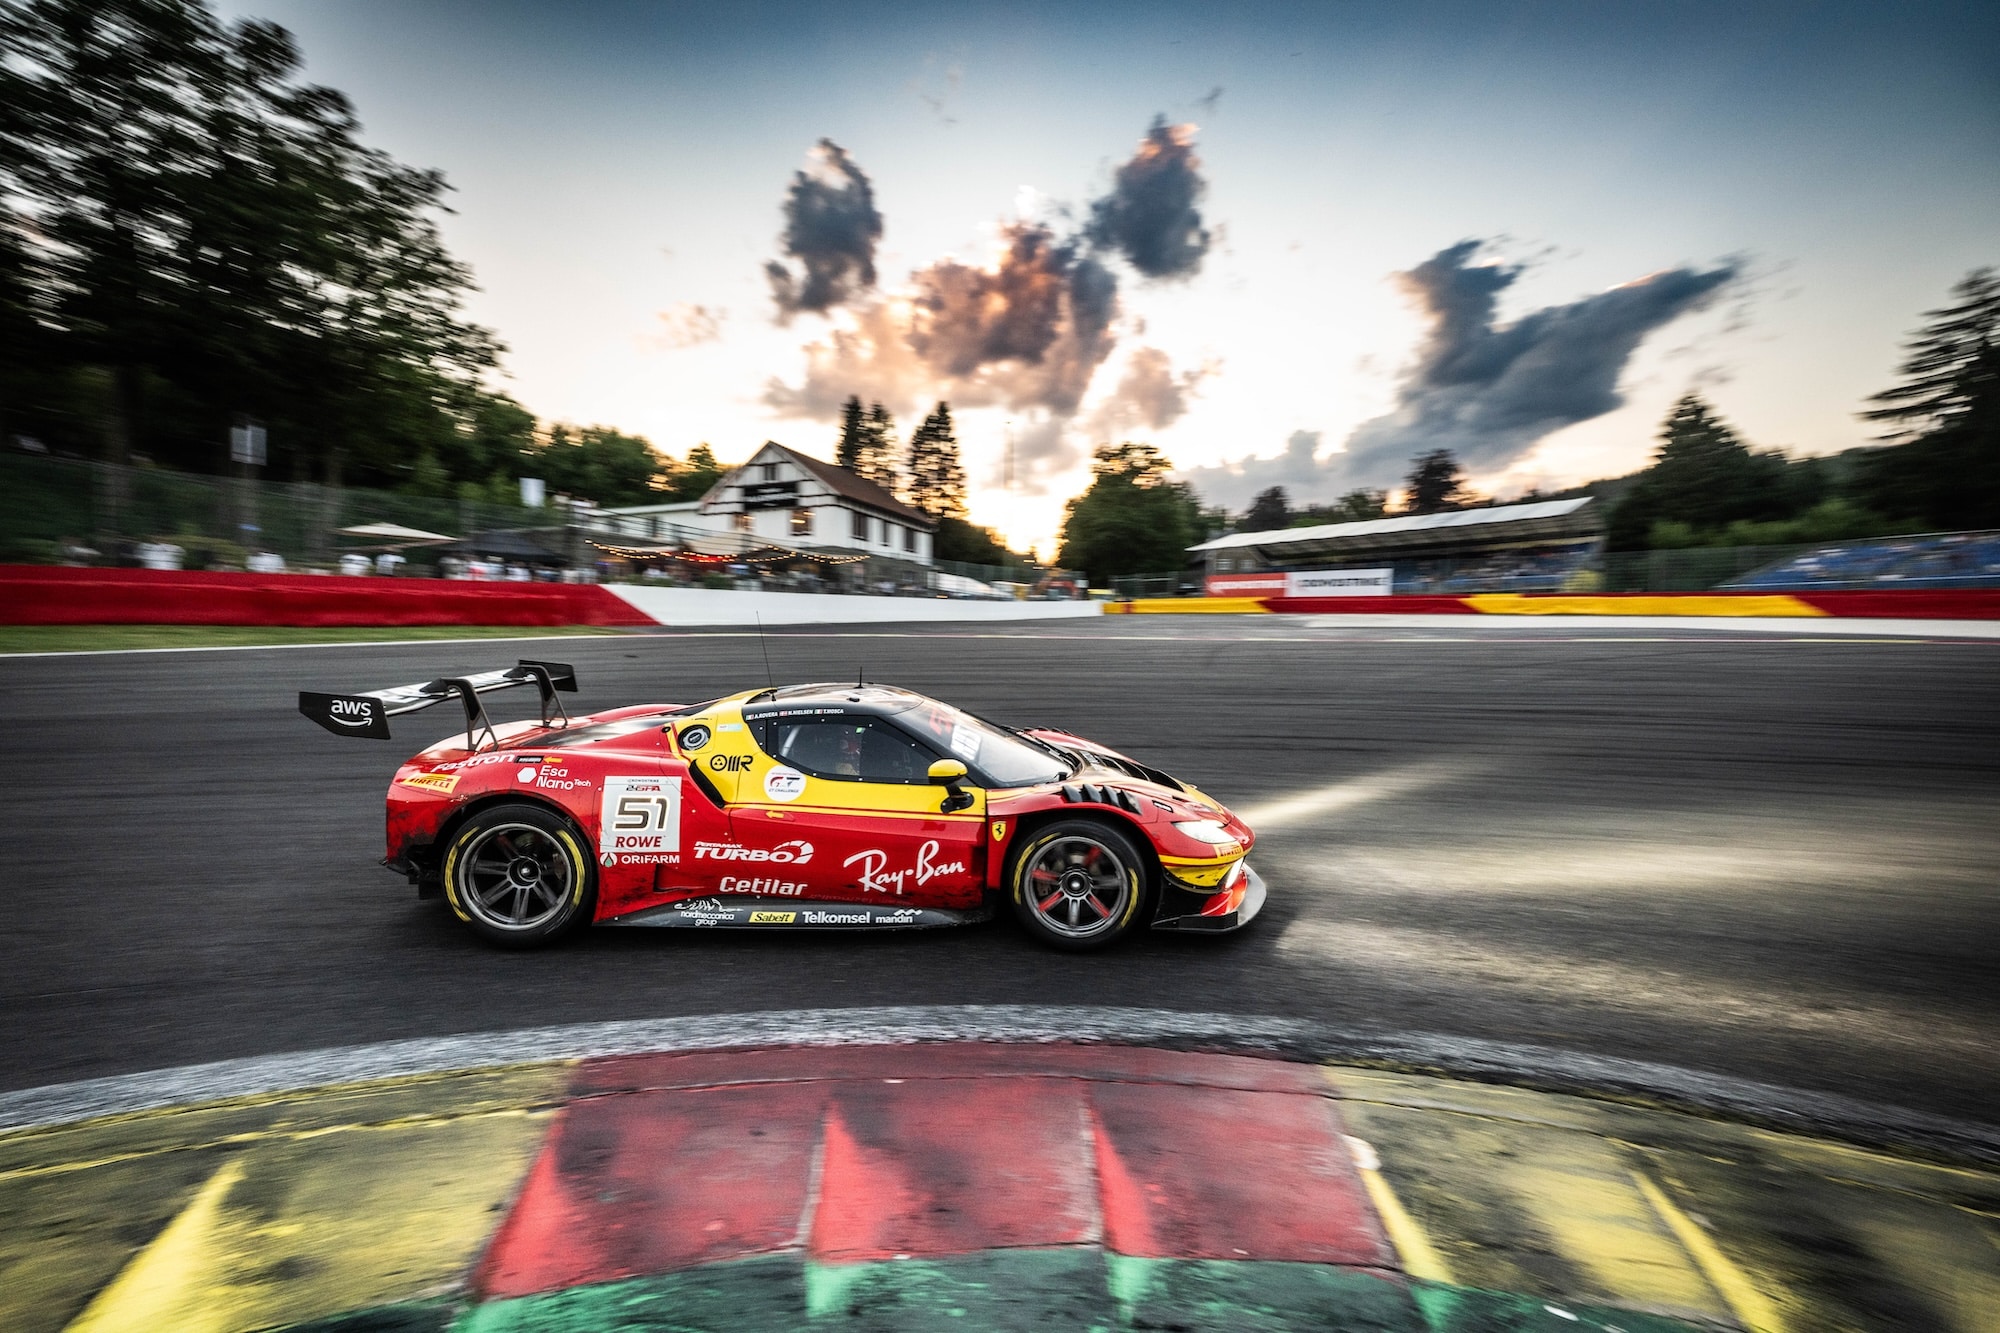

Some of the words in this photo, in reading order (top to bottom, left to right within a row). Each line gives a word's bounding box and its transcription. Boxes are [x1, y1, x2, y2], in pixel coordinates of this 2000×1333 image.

[331, 700, 371, 717] aws
[539, 765, 569, 778] Esa
[614, 796, 669, 830] 51
[615, 836, 662, 848] ROWE
[694, 841, 743, 849] PERTAMAX
[621, 854, 680, 864] ORIFARM
[693, 846, 794, 863] TURBO
[720, 876, 808, 895] Cetilar
[680, 910, 735, 920] nordmeccanica
[754, 912, 790, 922] Sabelt
[802, 911, 870, 924] Telkomsel
[695, 918, 718, 927] group
